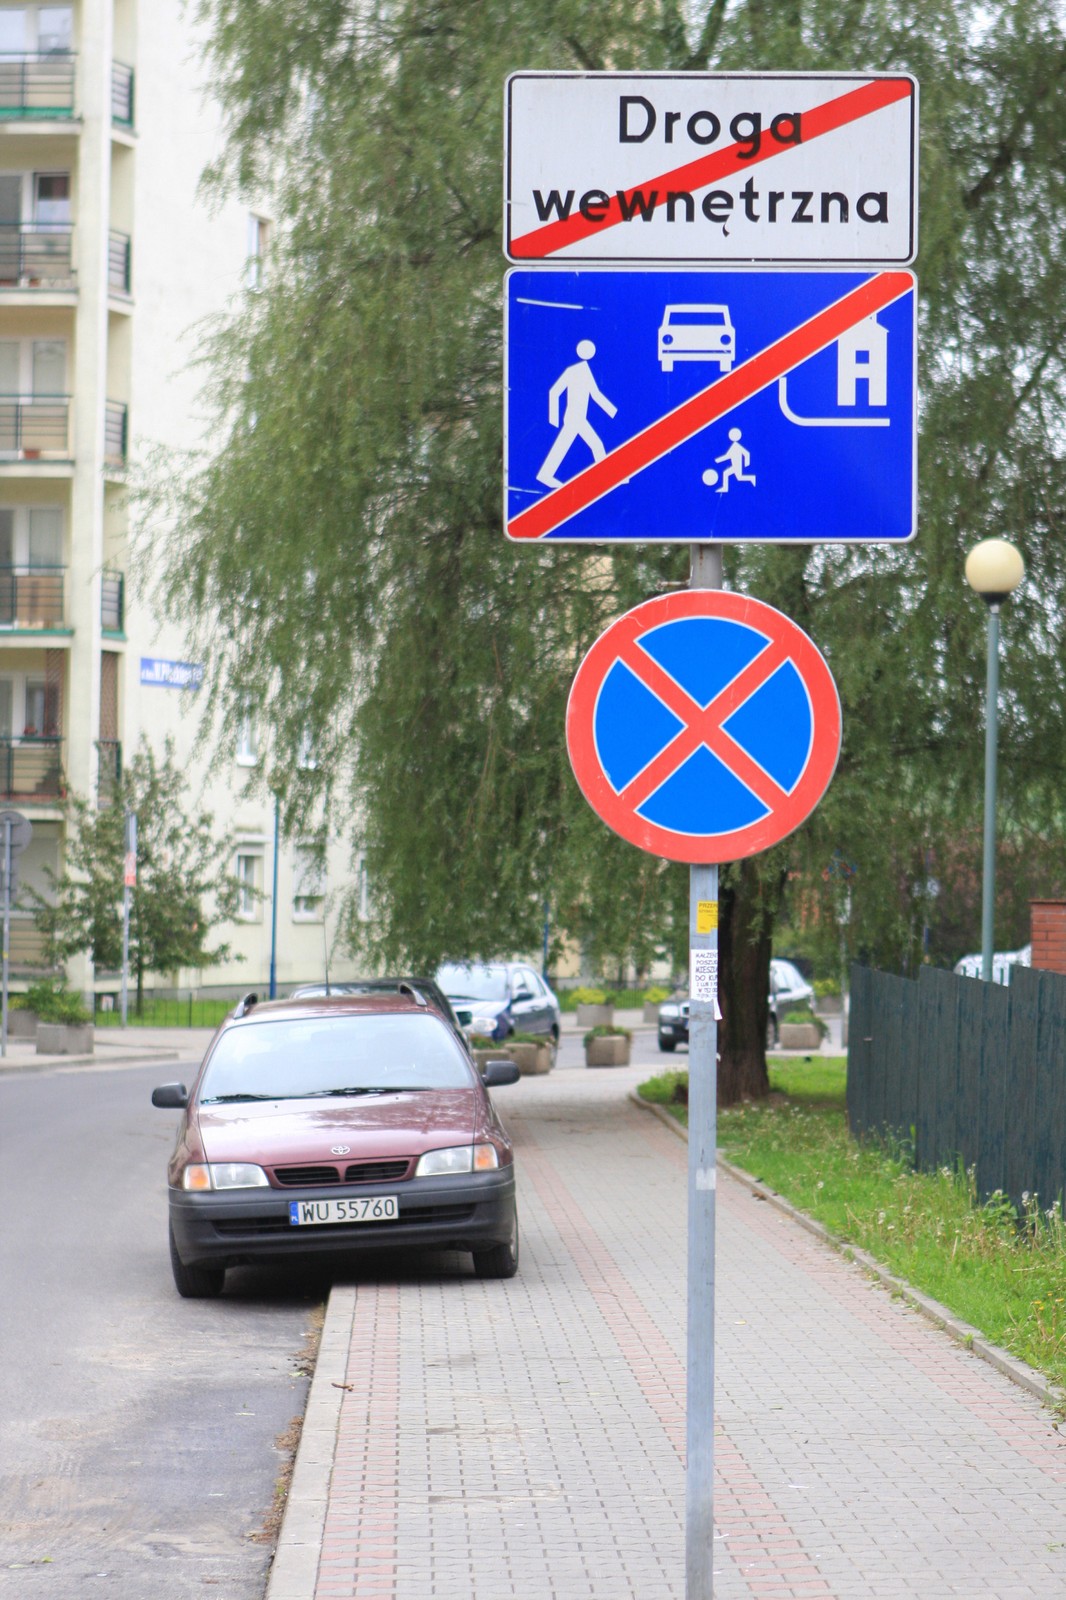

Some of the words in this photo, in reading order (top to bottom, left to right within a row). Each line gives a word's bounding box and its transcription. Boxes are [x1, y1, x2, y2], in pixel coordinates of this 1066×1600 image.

[619, 95, 802, 159] Droga
[532, 176, 889, 238] wewnętrzna
[302, 1202, 329, 1222] WU
[336, 1198, 395, 1220] 55760
